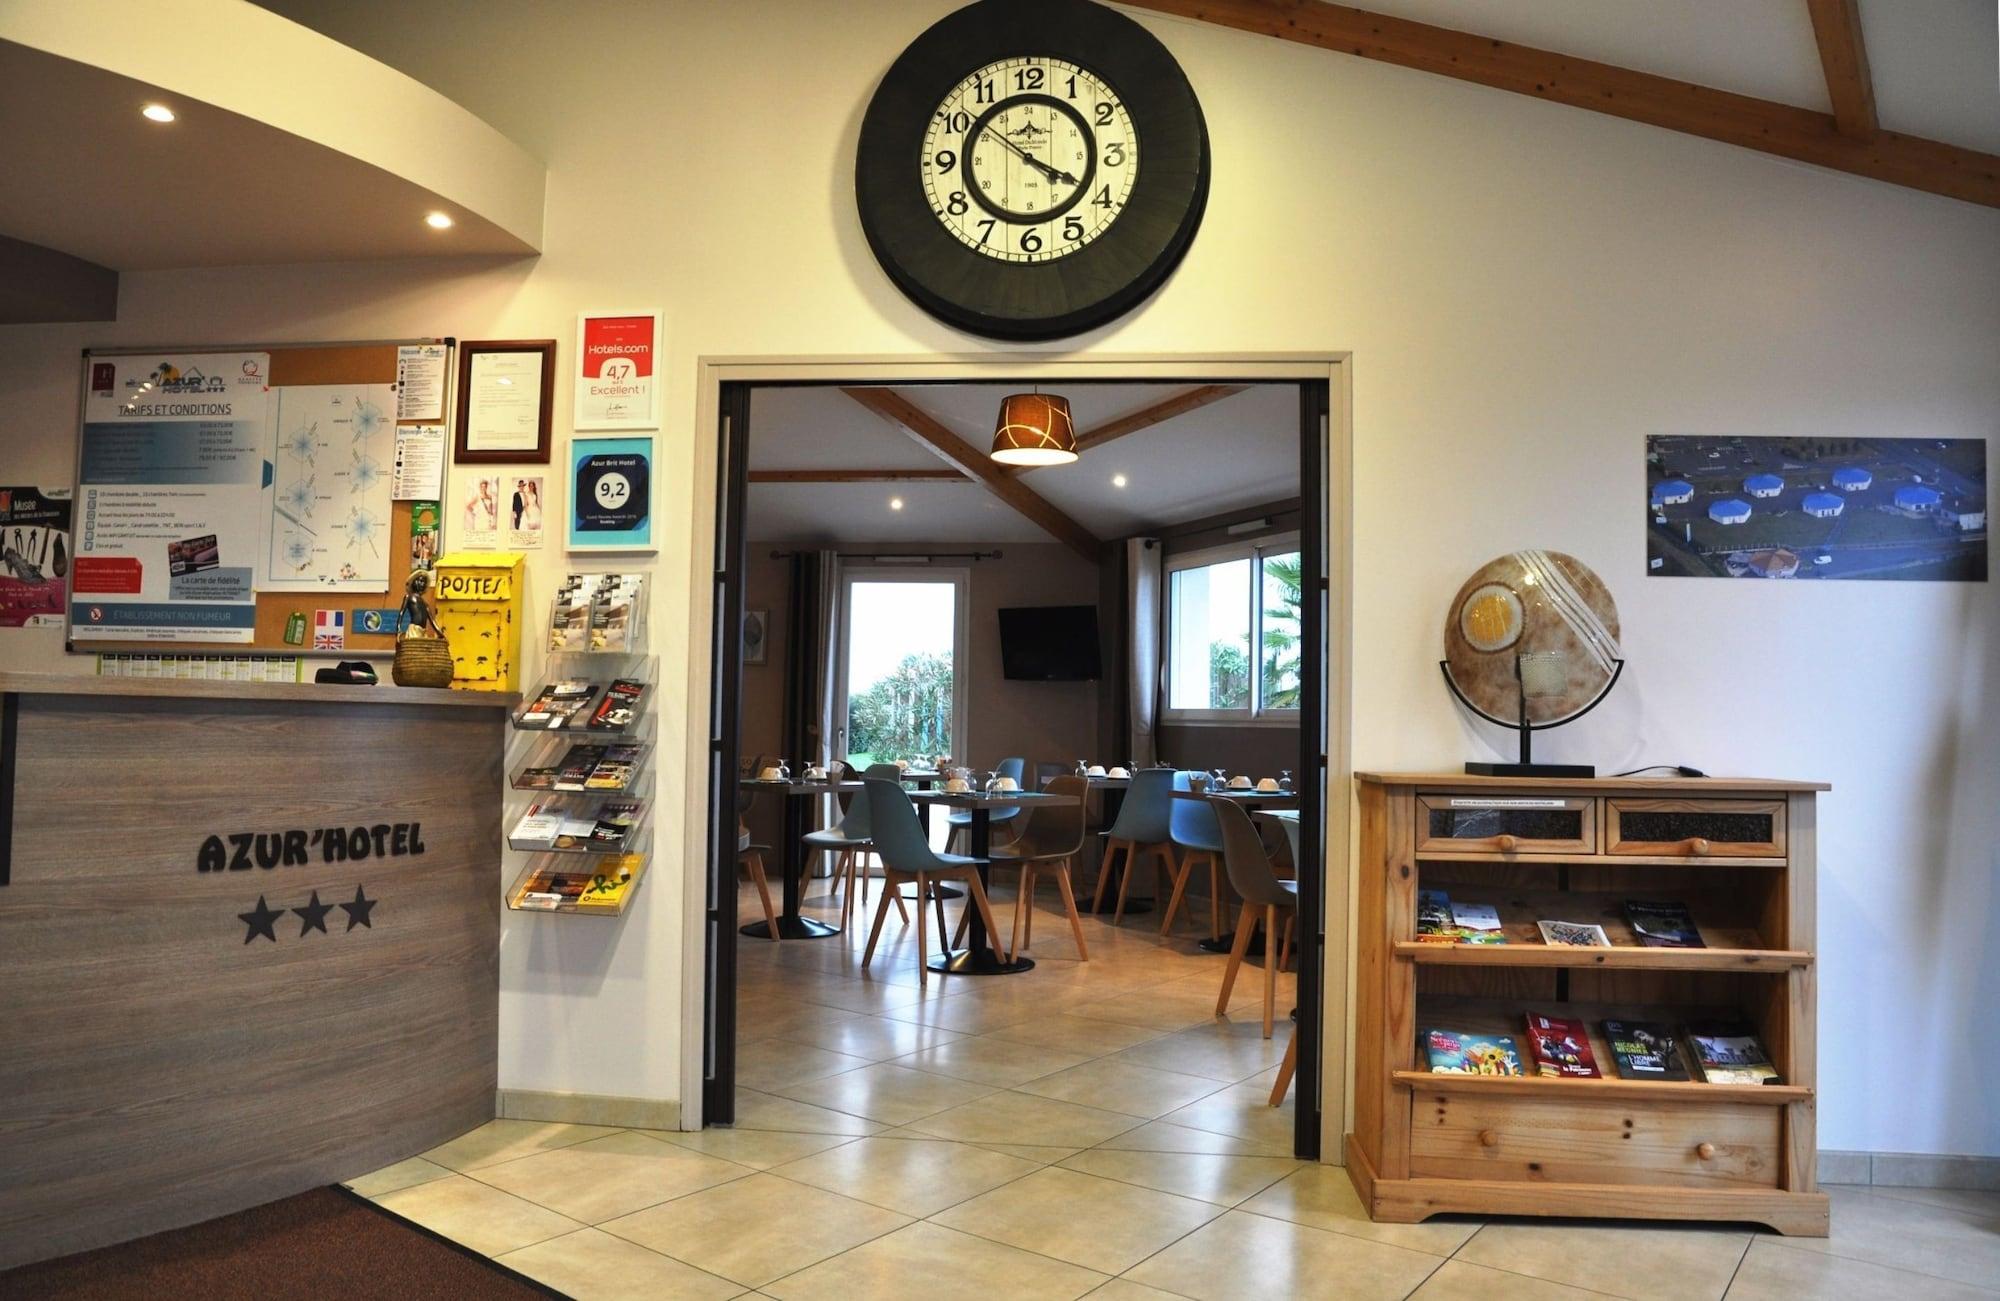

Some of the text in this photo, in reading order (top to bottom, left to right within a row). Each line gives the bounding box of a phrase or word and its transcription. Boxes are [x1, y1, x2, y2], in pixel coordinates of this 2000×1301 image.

[1014, 67, 1044, 90] 12
[1065, 75, 1077, 99] 1
[974, 79, 995, 104] 11
[1024, 106, 1033, 115] 24
[1095, 102, 1114, 126] 2
[943, 111, 969, 134] 10
[980, 133, 990, 142] 22
[935, 150, 956, 175] 9
[975, 156, 982, 166] 21
[1103, 142, 1126, 167] 3
[982, 180, 991, 190] 20
[1091, 184, 1113, 209] 4
[947, 191, 969, 216] 8
[976, 220, 996, 244] 7
[1020, 227, 1042, 253] 6
[1063, 216, 1085, 241] 5
[588, 344, 649, 355] Hotels.com
[607, 365, 630, 380] 4,7
[590, 385, 639, 396] Excellent
[118, 403, 232, 416] TARIFS ET CONDITIONS
[601, 482, 625, 499] 9,2
[440, 576, 502, 595] POSTES
[197, 611, 231, 621] FUMEUR
